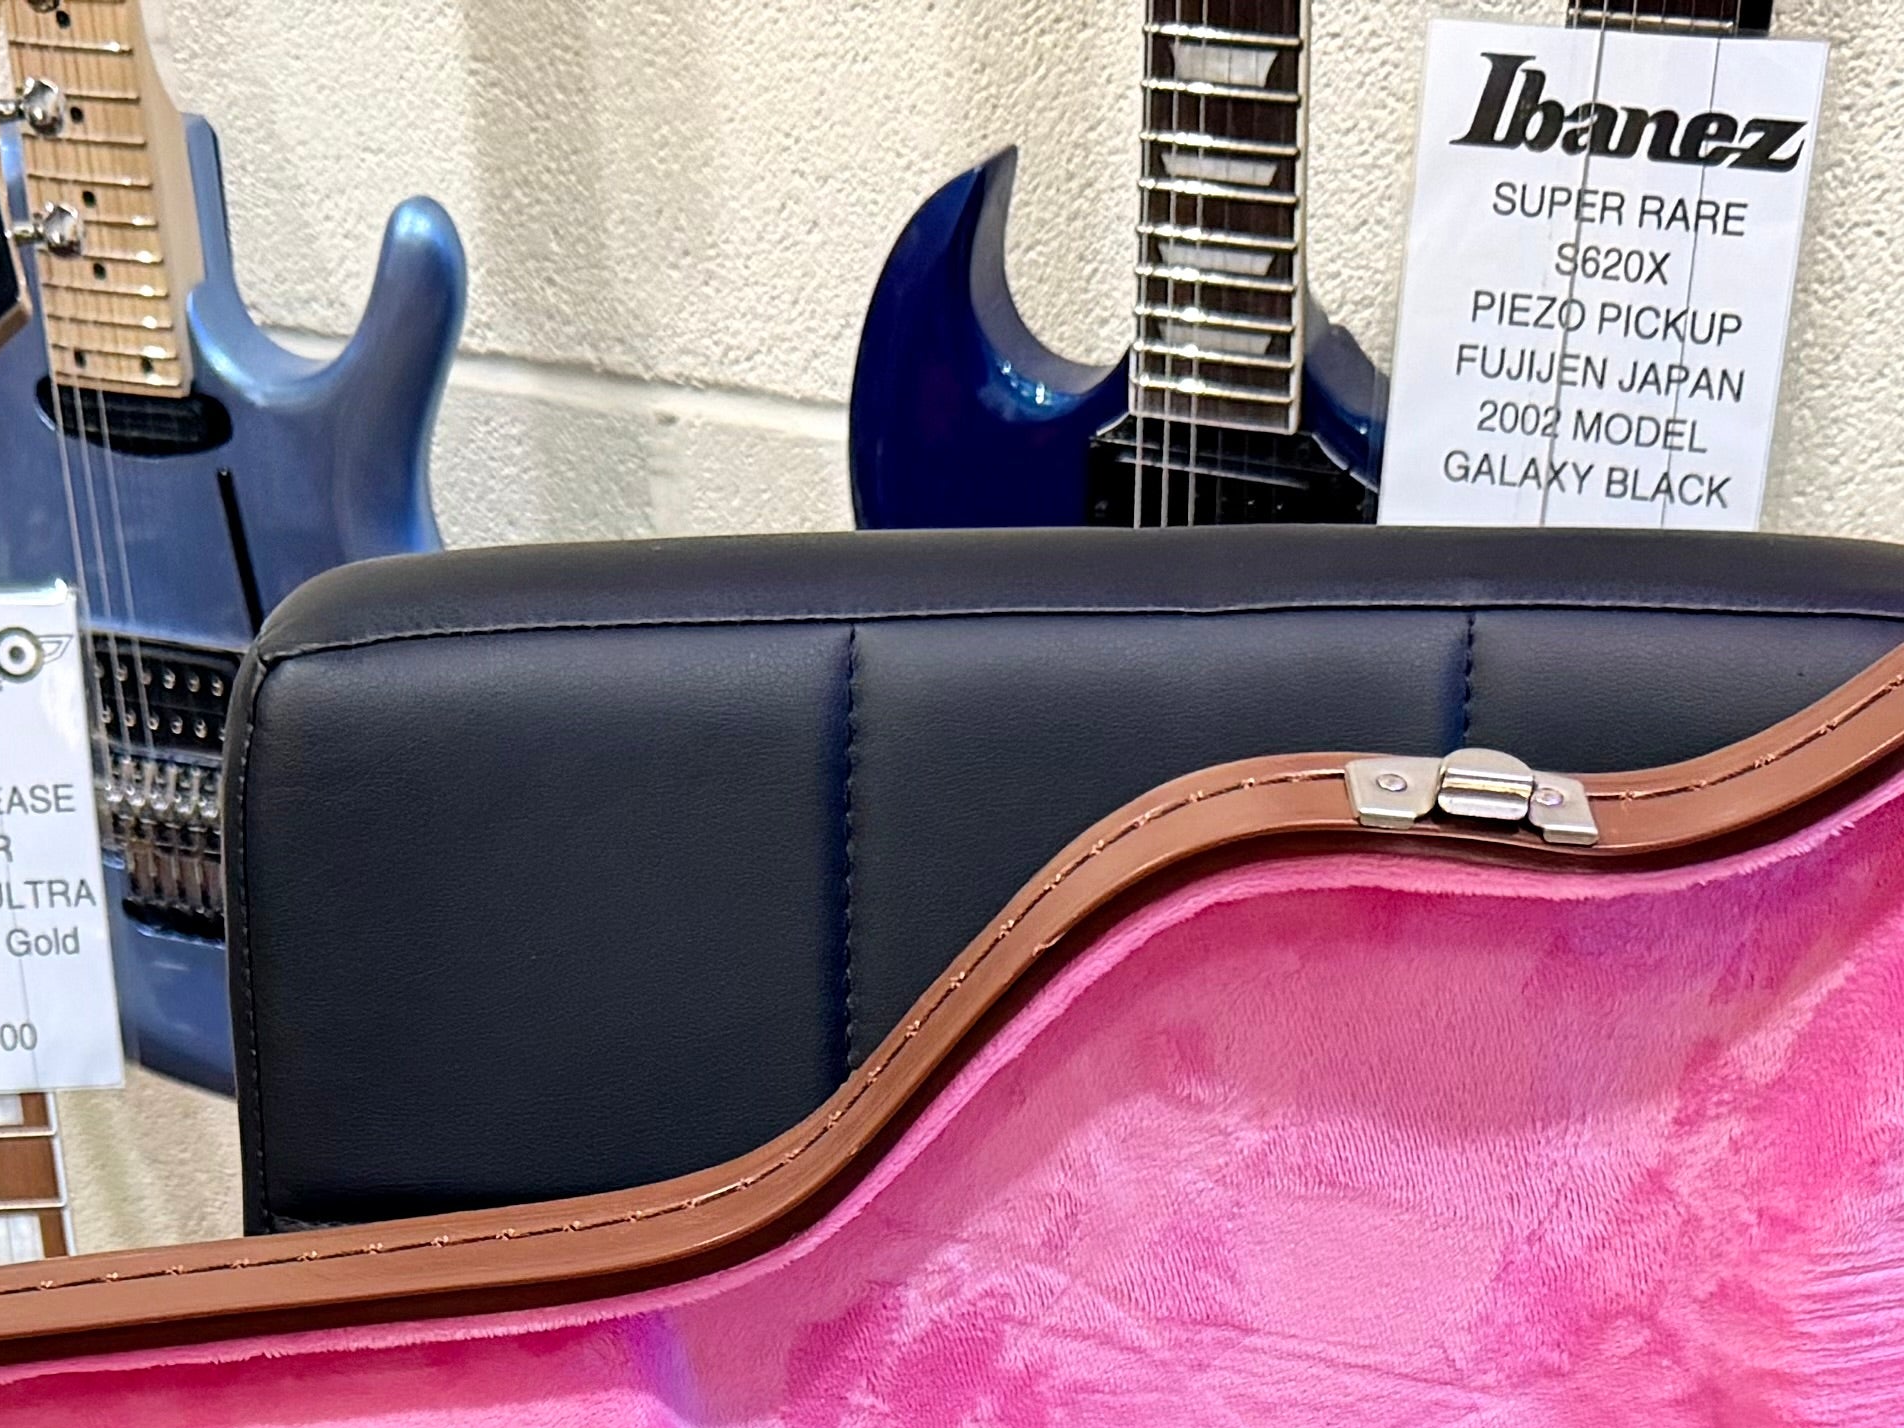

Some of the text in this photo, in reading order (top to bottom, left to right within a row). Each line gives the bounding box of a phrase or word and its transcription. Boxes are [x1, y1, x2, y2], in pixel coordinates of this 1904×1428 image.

[1449, 52, 1809, 172] Ibanez
[1492, 182, 1748, 237] SUPER RARE
[1554, 243, 1671, 285] S620X
[1471, 291, 1743, 346] PIEZO PICKUP
[1456, 345, 1744, 403] FUJIJEN JAPAN
[1477, 400, 1707, 454] 2002 MODEL
[1443, 450, 1731, 508] GALAXY BLACK
[6, 926, 80, 957] Gold
